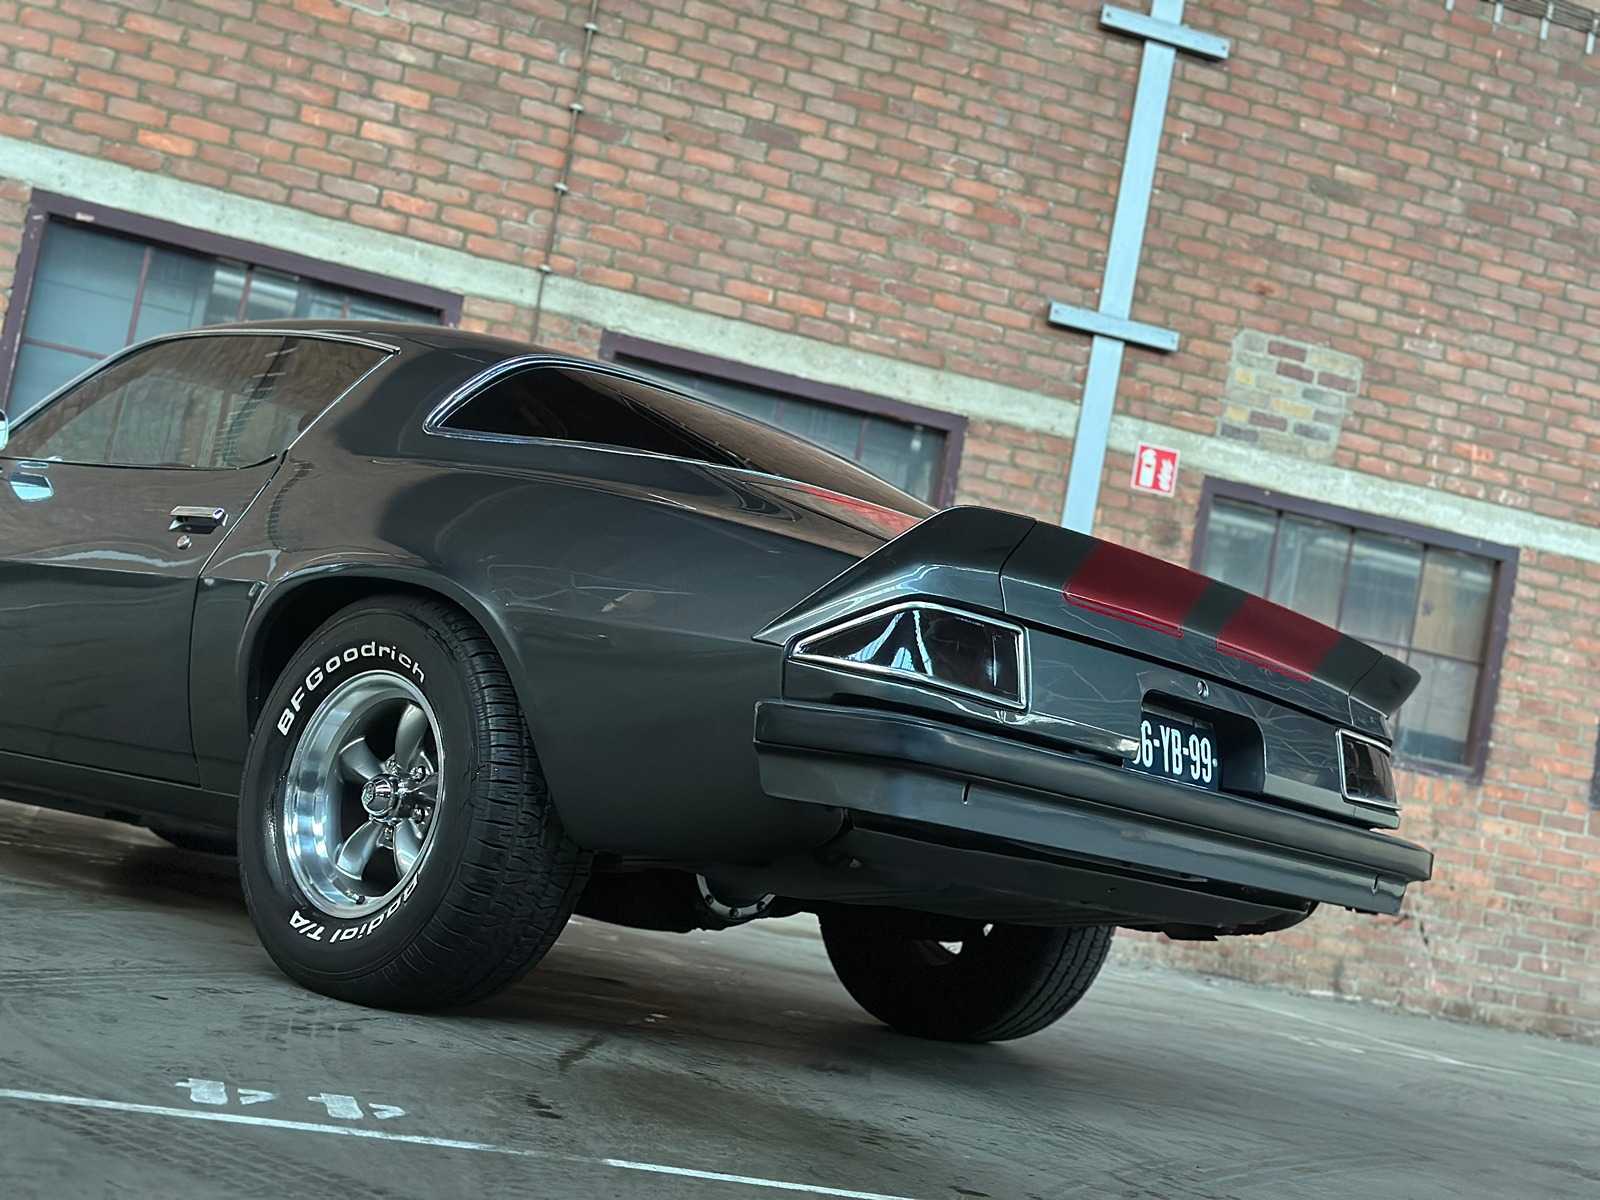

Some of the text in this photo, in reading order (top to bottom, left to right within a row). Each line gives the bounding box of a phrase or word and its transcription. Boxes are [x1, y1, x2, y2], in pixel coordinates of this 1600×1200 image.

[277, 641, 425, 736] BFGoodrich
[1132, 720, 1213, 783] 6-YB-99
[289, 910, 325, 941] T/A
